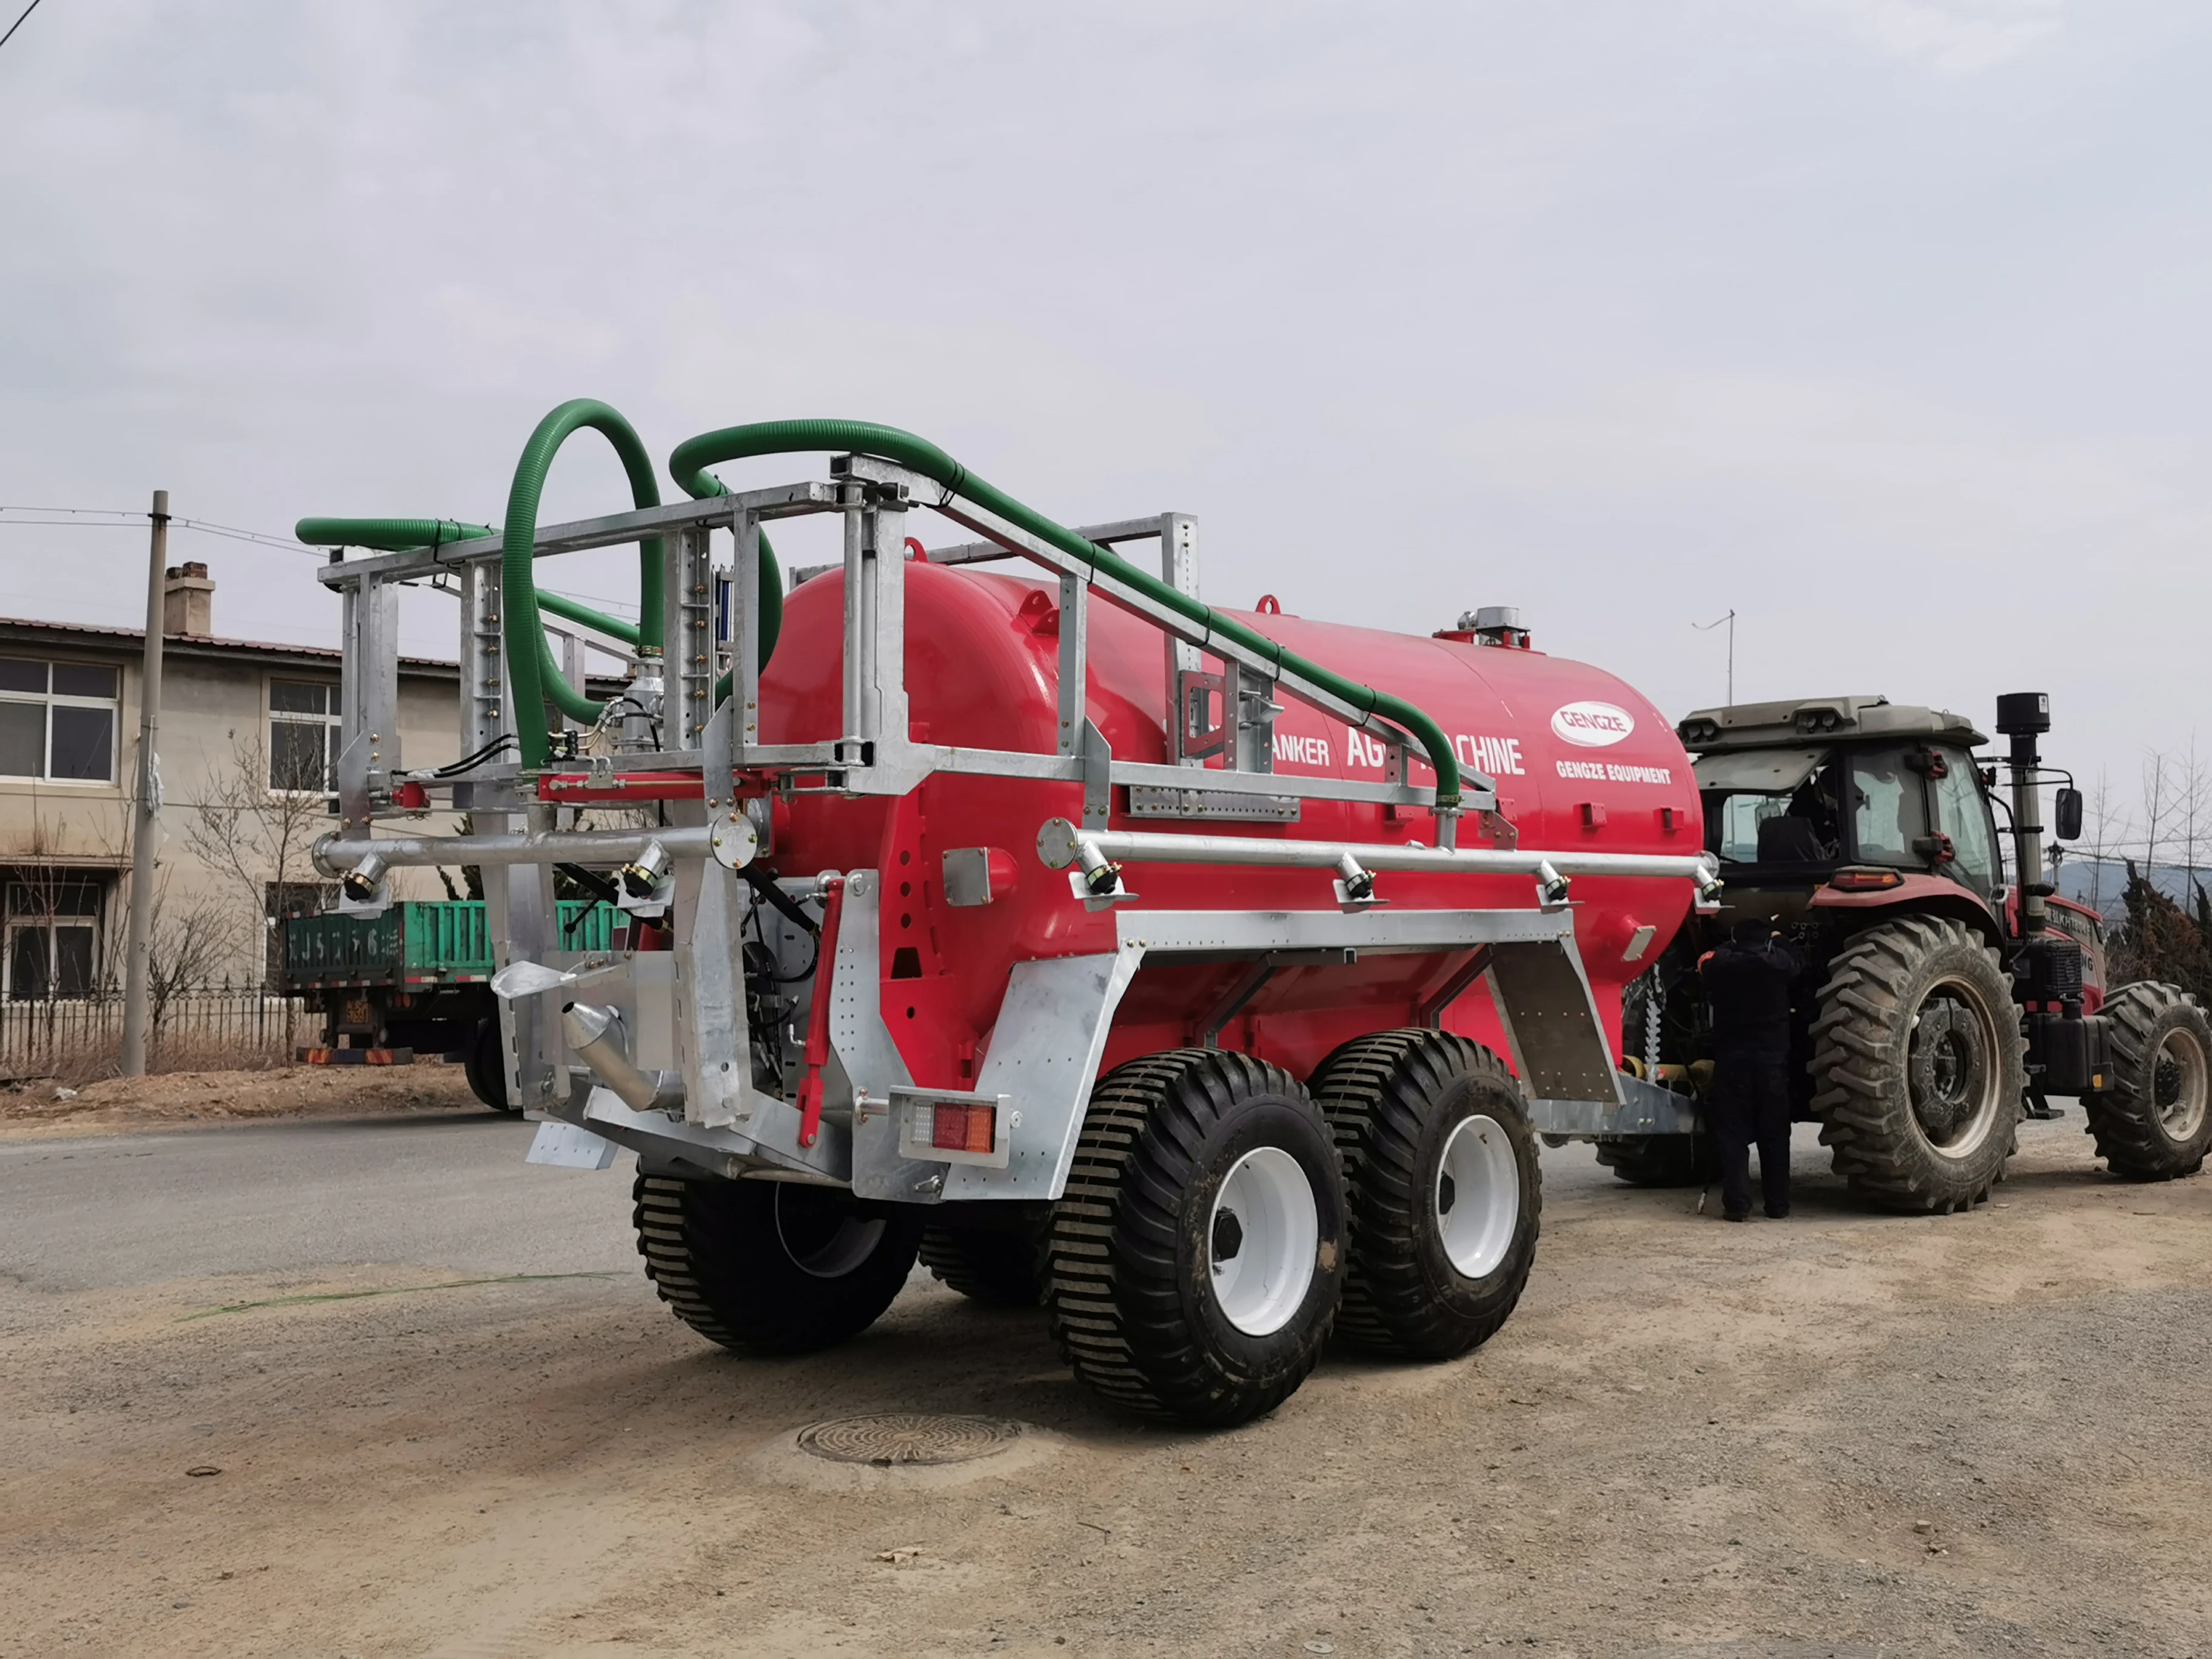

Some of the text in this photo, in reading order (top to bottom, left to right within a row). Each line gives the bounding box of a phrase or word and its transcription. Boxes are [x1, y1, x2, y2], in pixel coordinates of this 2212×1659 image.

[1560, 711, 1627, 732] GENGZE
[1272, 734, 1330, 766] ANKER
[1556, 760, 1672, 785] GENGZE EQUIPMENT
